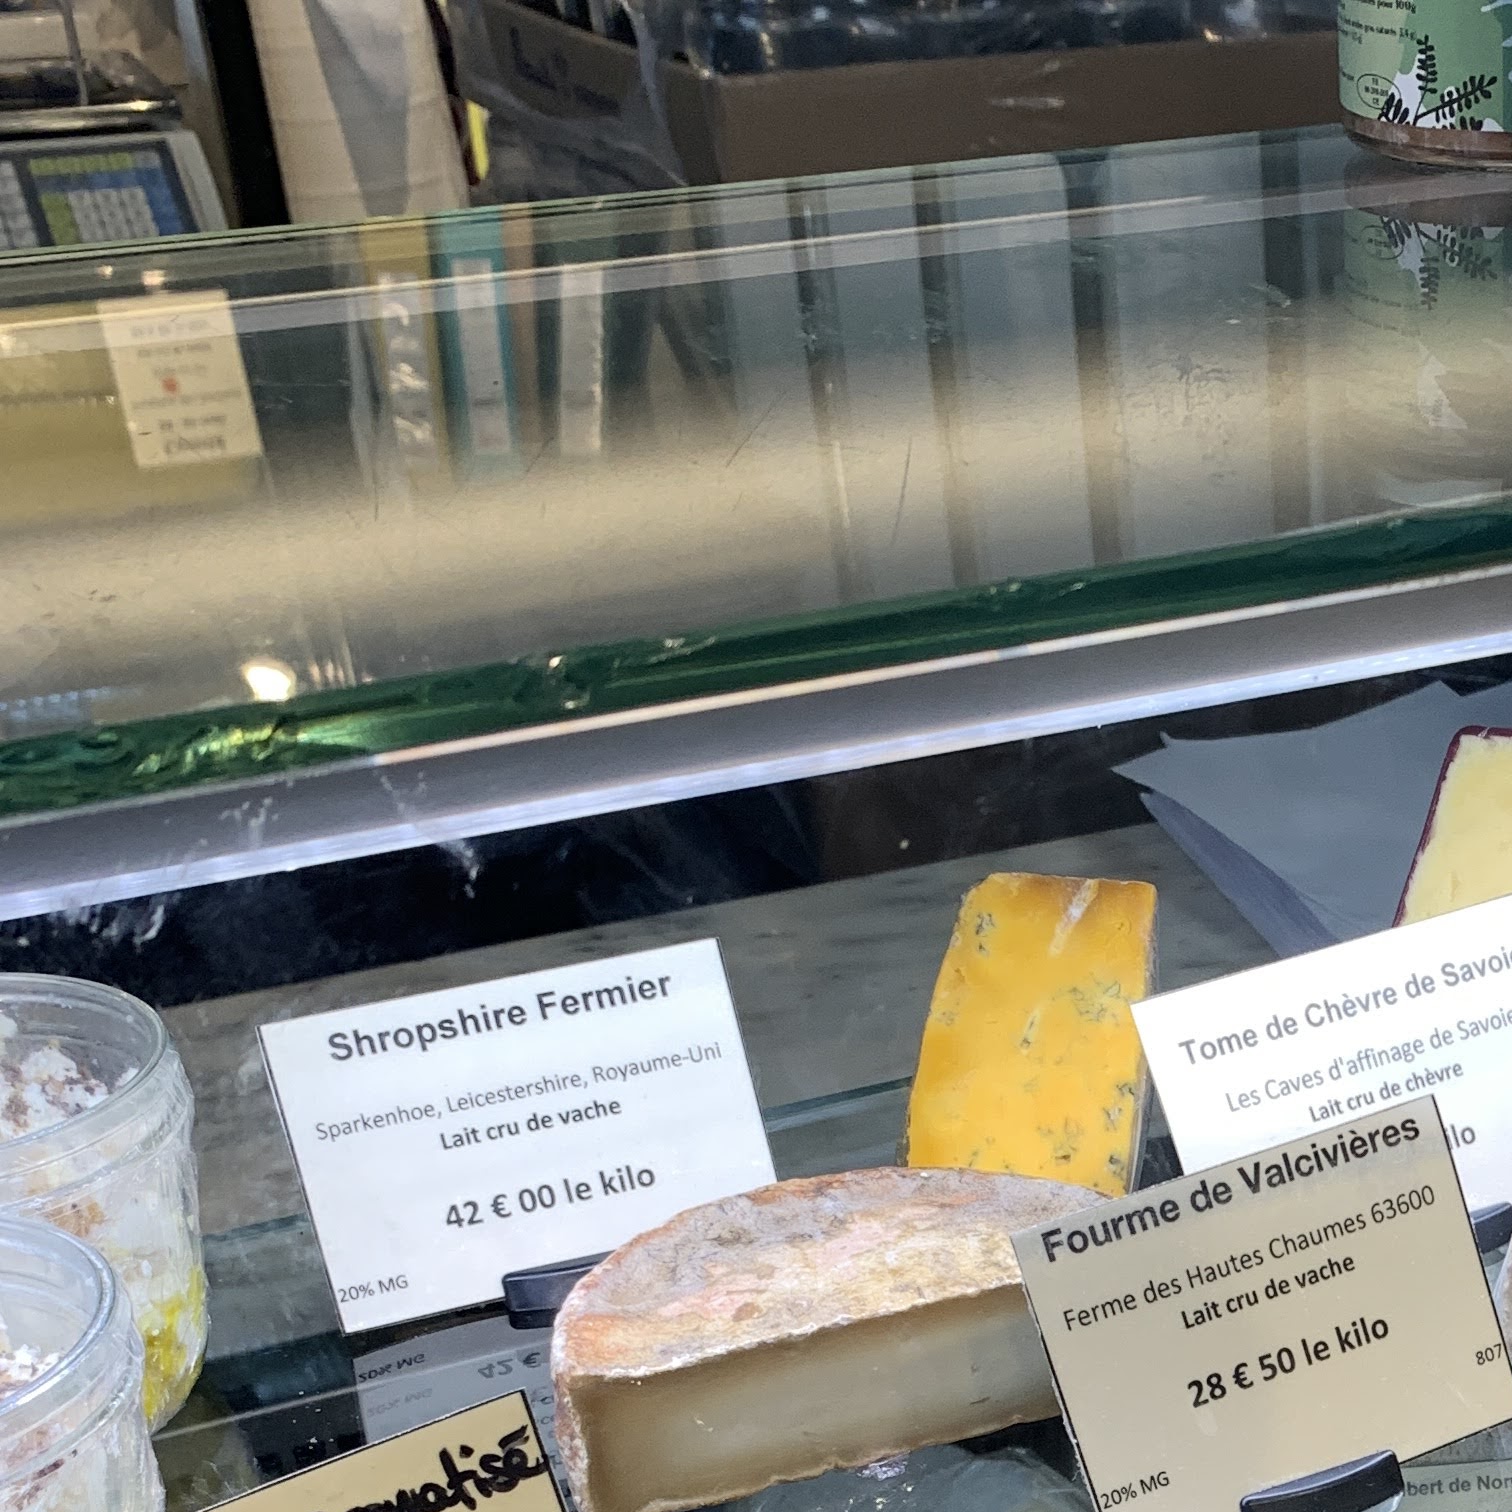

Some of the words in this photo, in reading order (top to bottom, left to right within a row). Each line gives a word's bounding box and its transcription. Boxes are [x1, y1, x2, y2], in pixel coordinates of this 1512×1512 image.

[327, 999, 528, 1061] Shropshire
[535, 973, 673, 1021] Fermier
[1178, 1030, 1260, 1066] Tome
[1265, 1013, 1300, 1040] de
[1303, 981, 1399, 1029] Chèvre
[1404, 974, 1436, 1000] de
[315, 1100, 443, 1143] Sparkenhoe,
[445, 1069, 588, 1114] Leicestershire,
[592, 1042, 723, 1087] Royaume-Uni
[1226, 1086, 1261, 1112] Les
[1264, 1065, 1325, 1102] Caves
[1328, 1038, 1425, 1082] d'affinage
[1429, 1026, 1456, 1047] de
[440, 1126, 480, 1151] Lait
[486, 1118, 520, 1141] cru
[526, 1109, 554, 1132] de
[557, 1099, 622, 1125] vache
[1041, 1194, 1181, 1262] Fourme
[1190, 1179, 1233, 1214] de
[1237, 1116, 1421, 1194] Valcivières
[338, 1282, 375, 1303] 20%
[382, 1273, 410, 1295] MG
[1063, 1292, 1137, 1332] Ferme
[1143, 1277, 1182, 1304] des
[1185, 1248, 1265, 1291] Hautes
[1269, 1213, 1367, 1260] Chaumes
[1370, 1184, 1435, 1222] 63600
[1186, 1372, 1227, 1408] 28
[1232, 1362, 1254, 1389] €
[1258, 1345, 1297, 1382] 50
[1301, 1335, 1331, 1367] le
[1335, 1313, 1390, 1354] kilo
[1100, 1483, 1137, 1510] 20%
[1139, 1470, 1170, 1495] MG
